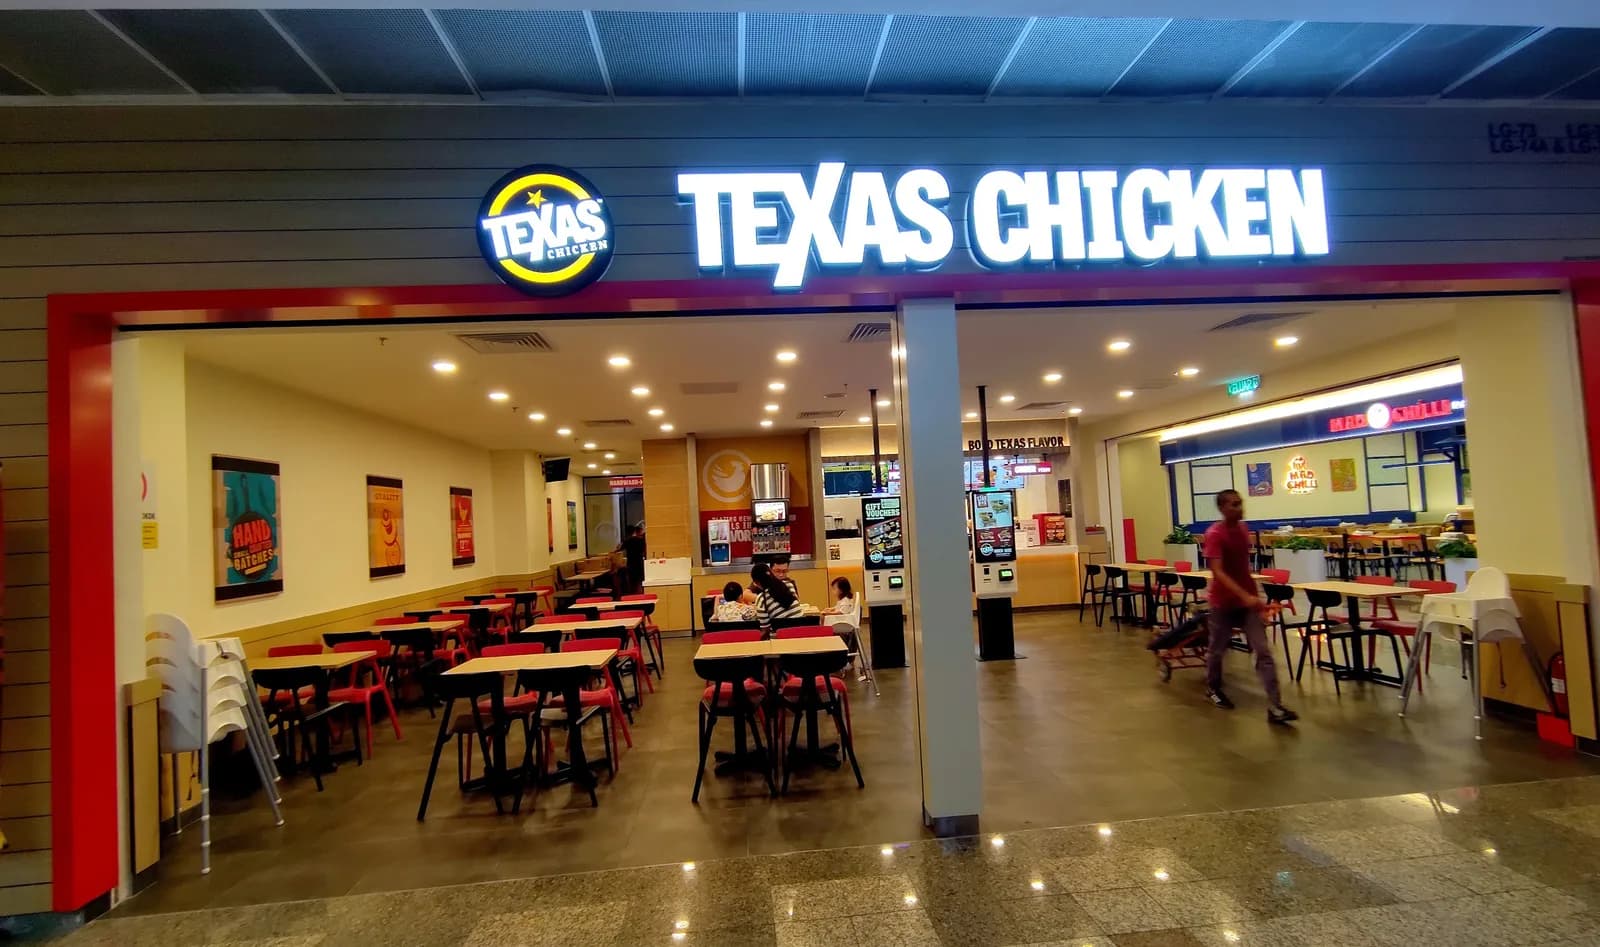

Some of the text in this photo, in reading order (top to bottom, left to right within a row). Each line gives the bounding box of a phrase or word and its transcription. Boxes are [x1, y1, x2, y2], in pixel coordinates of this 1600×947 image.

[1568, 138, 1600, 154] LG-
[482, 198, 606, 262] TEXAS
[677, 162, 1330, 289] TEXAS CHICKEN
[547, 240, 608, 260] CHICKEN
[1328, 413, 1367, 432] MAD
[968, 436, 1065, 450] BOD TEXAS FLAVOR
[865, 503, 881, 511] GIFT
[866, 509, 901, 518] VOUCHERS
[232, 518, 272, 548] HAND
[234, 549, 274, 571] BATCHES
